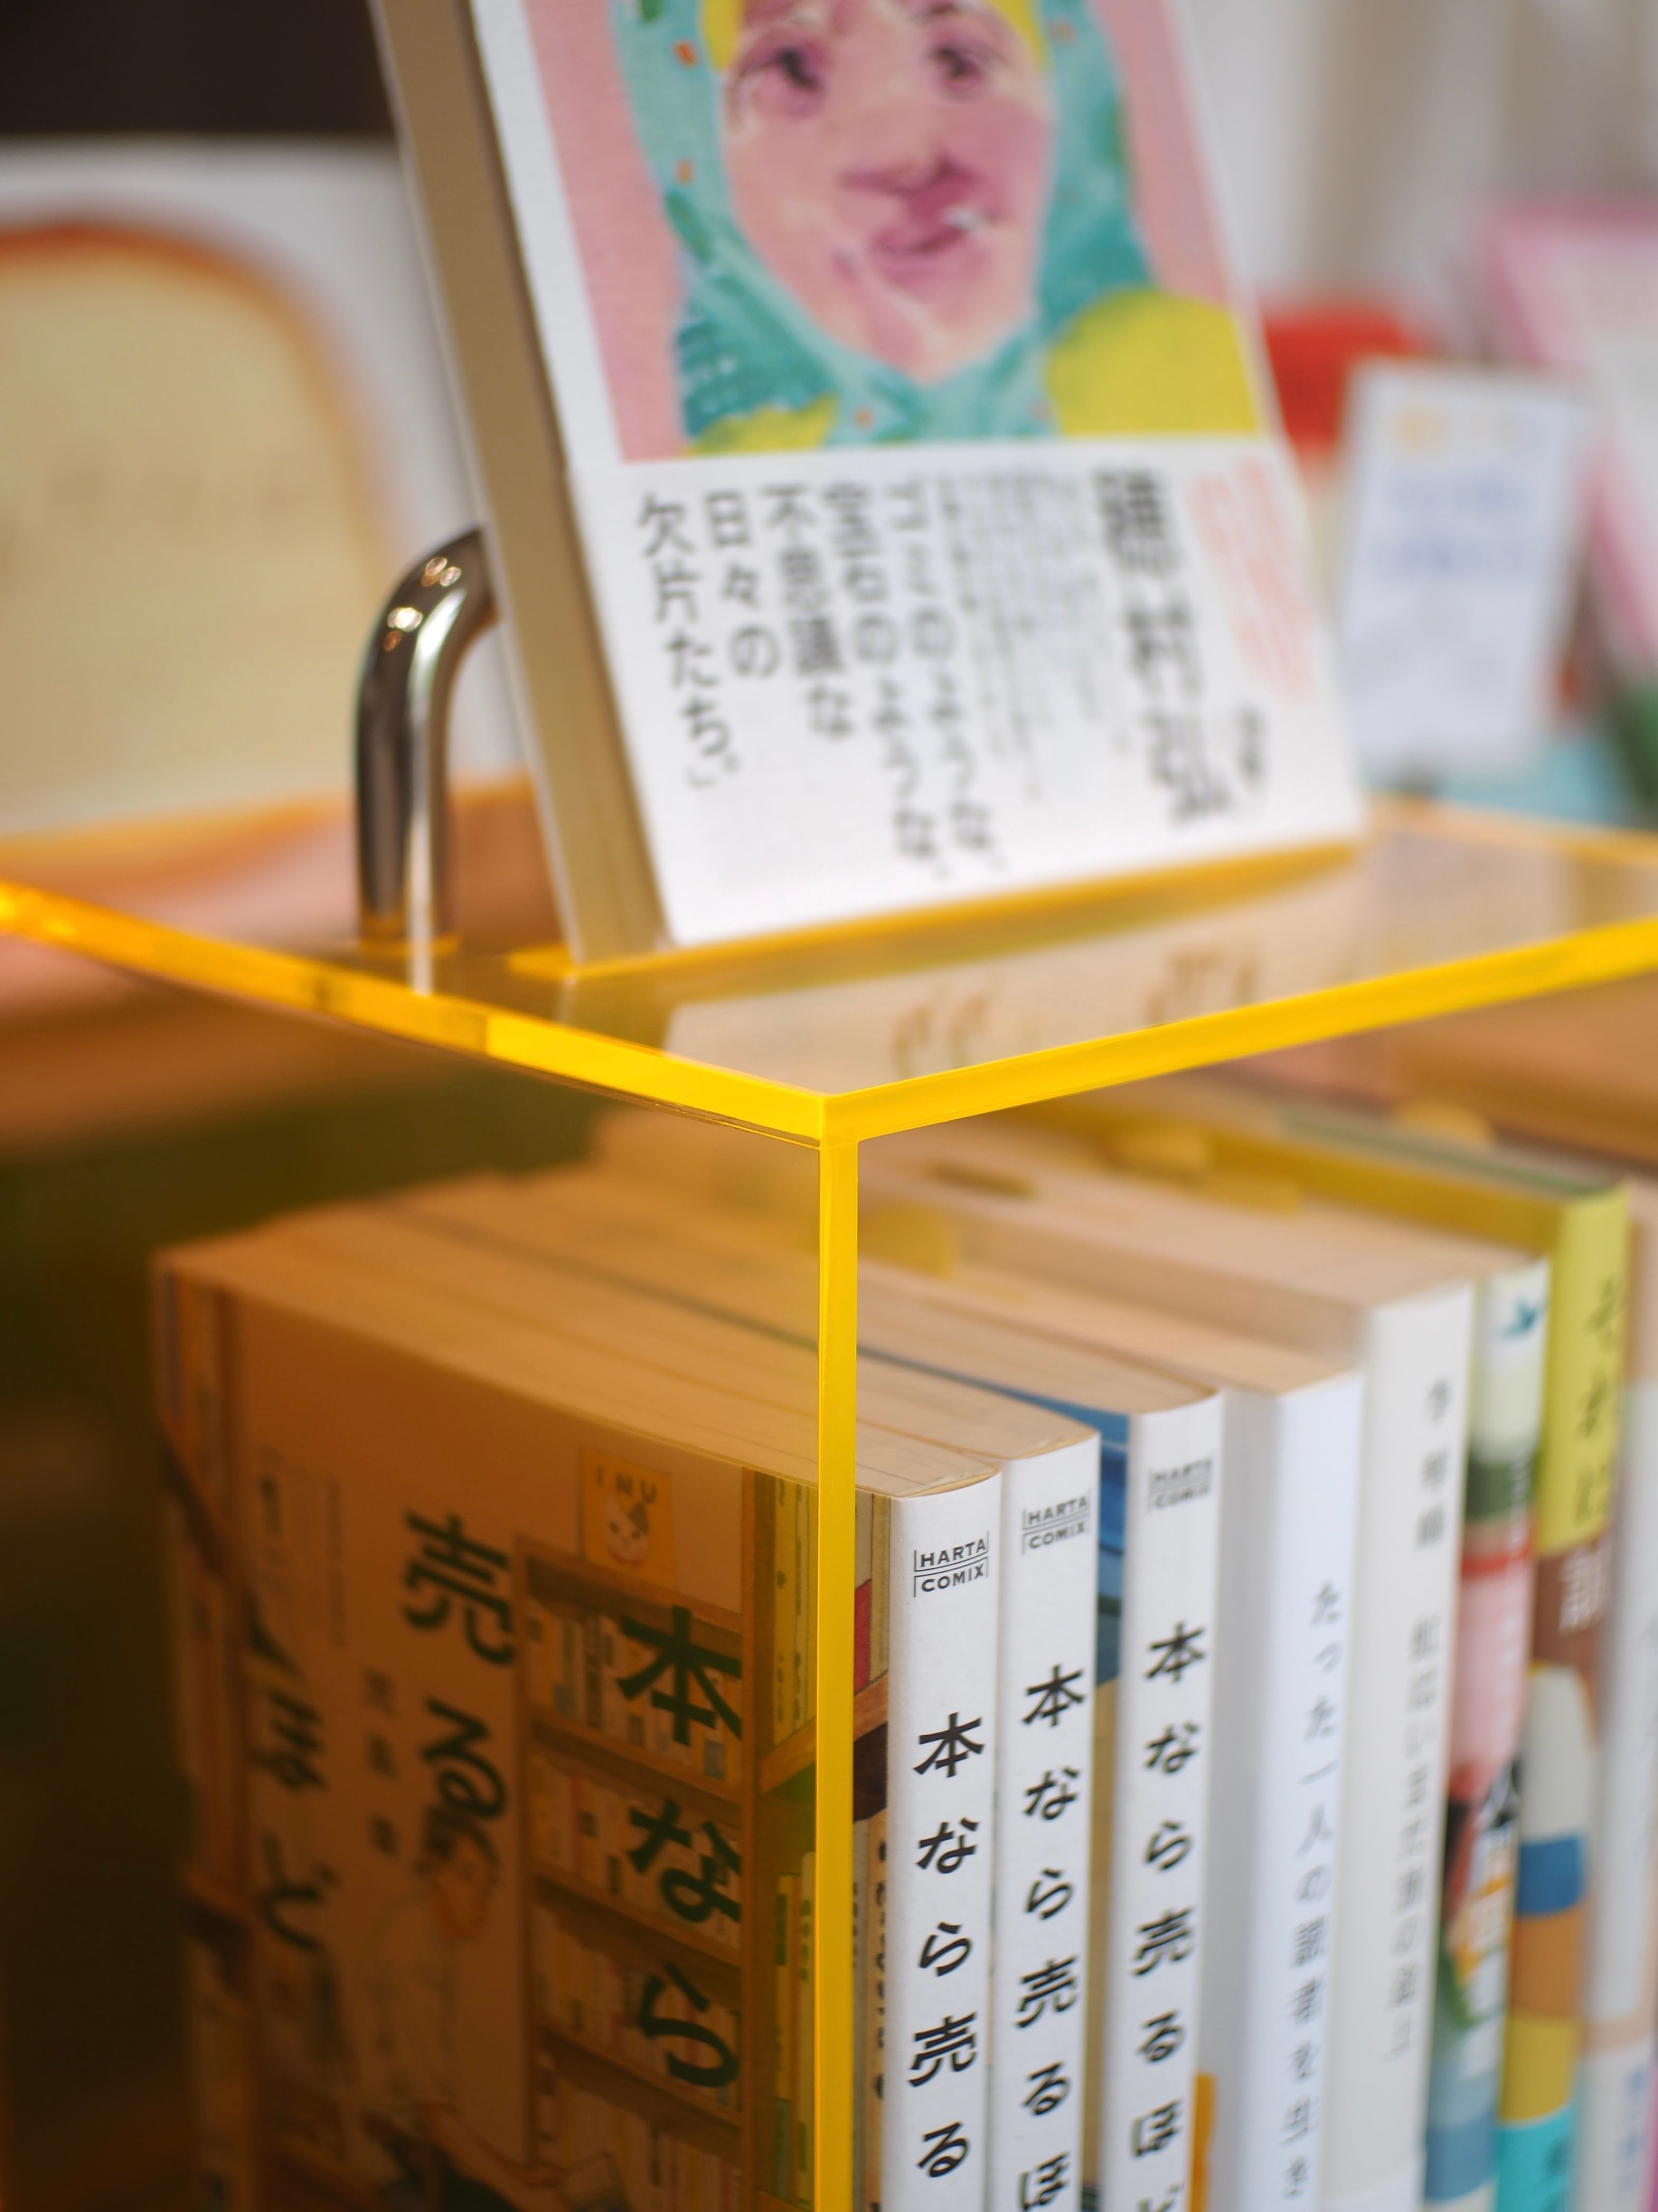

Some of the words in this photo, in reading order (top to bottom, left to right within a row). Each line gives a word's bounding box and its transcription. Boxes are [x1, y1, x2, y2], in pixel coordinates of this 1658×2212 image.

[704, 490, 780, 679] 日々の
[761, 484, 852, 736] 不思議な
[920, 1538, 986, 1568] HARTA
[921, 1564, 985, 1593] COMIX
[1028, 1495, 1088, 1525] HARTA
[1029, 1520, 1085, 1550] COMIX
[403, 1511, 516, 1816] 売る
[616, 1604, 742, 2089] 本なら
[908, 1711, 985, 2178] 本なら売る
[1014, 1664, 1085, 2211] 本なら売るほ
